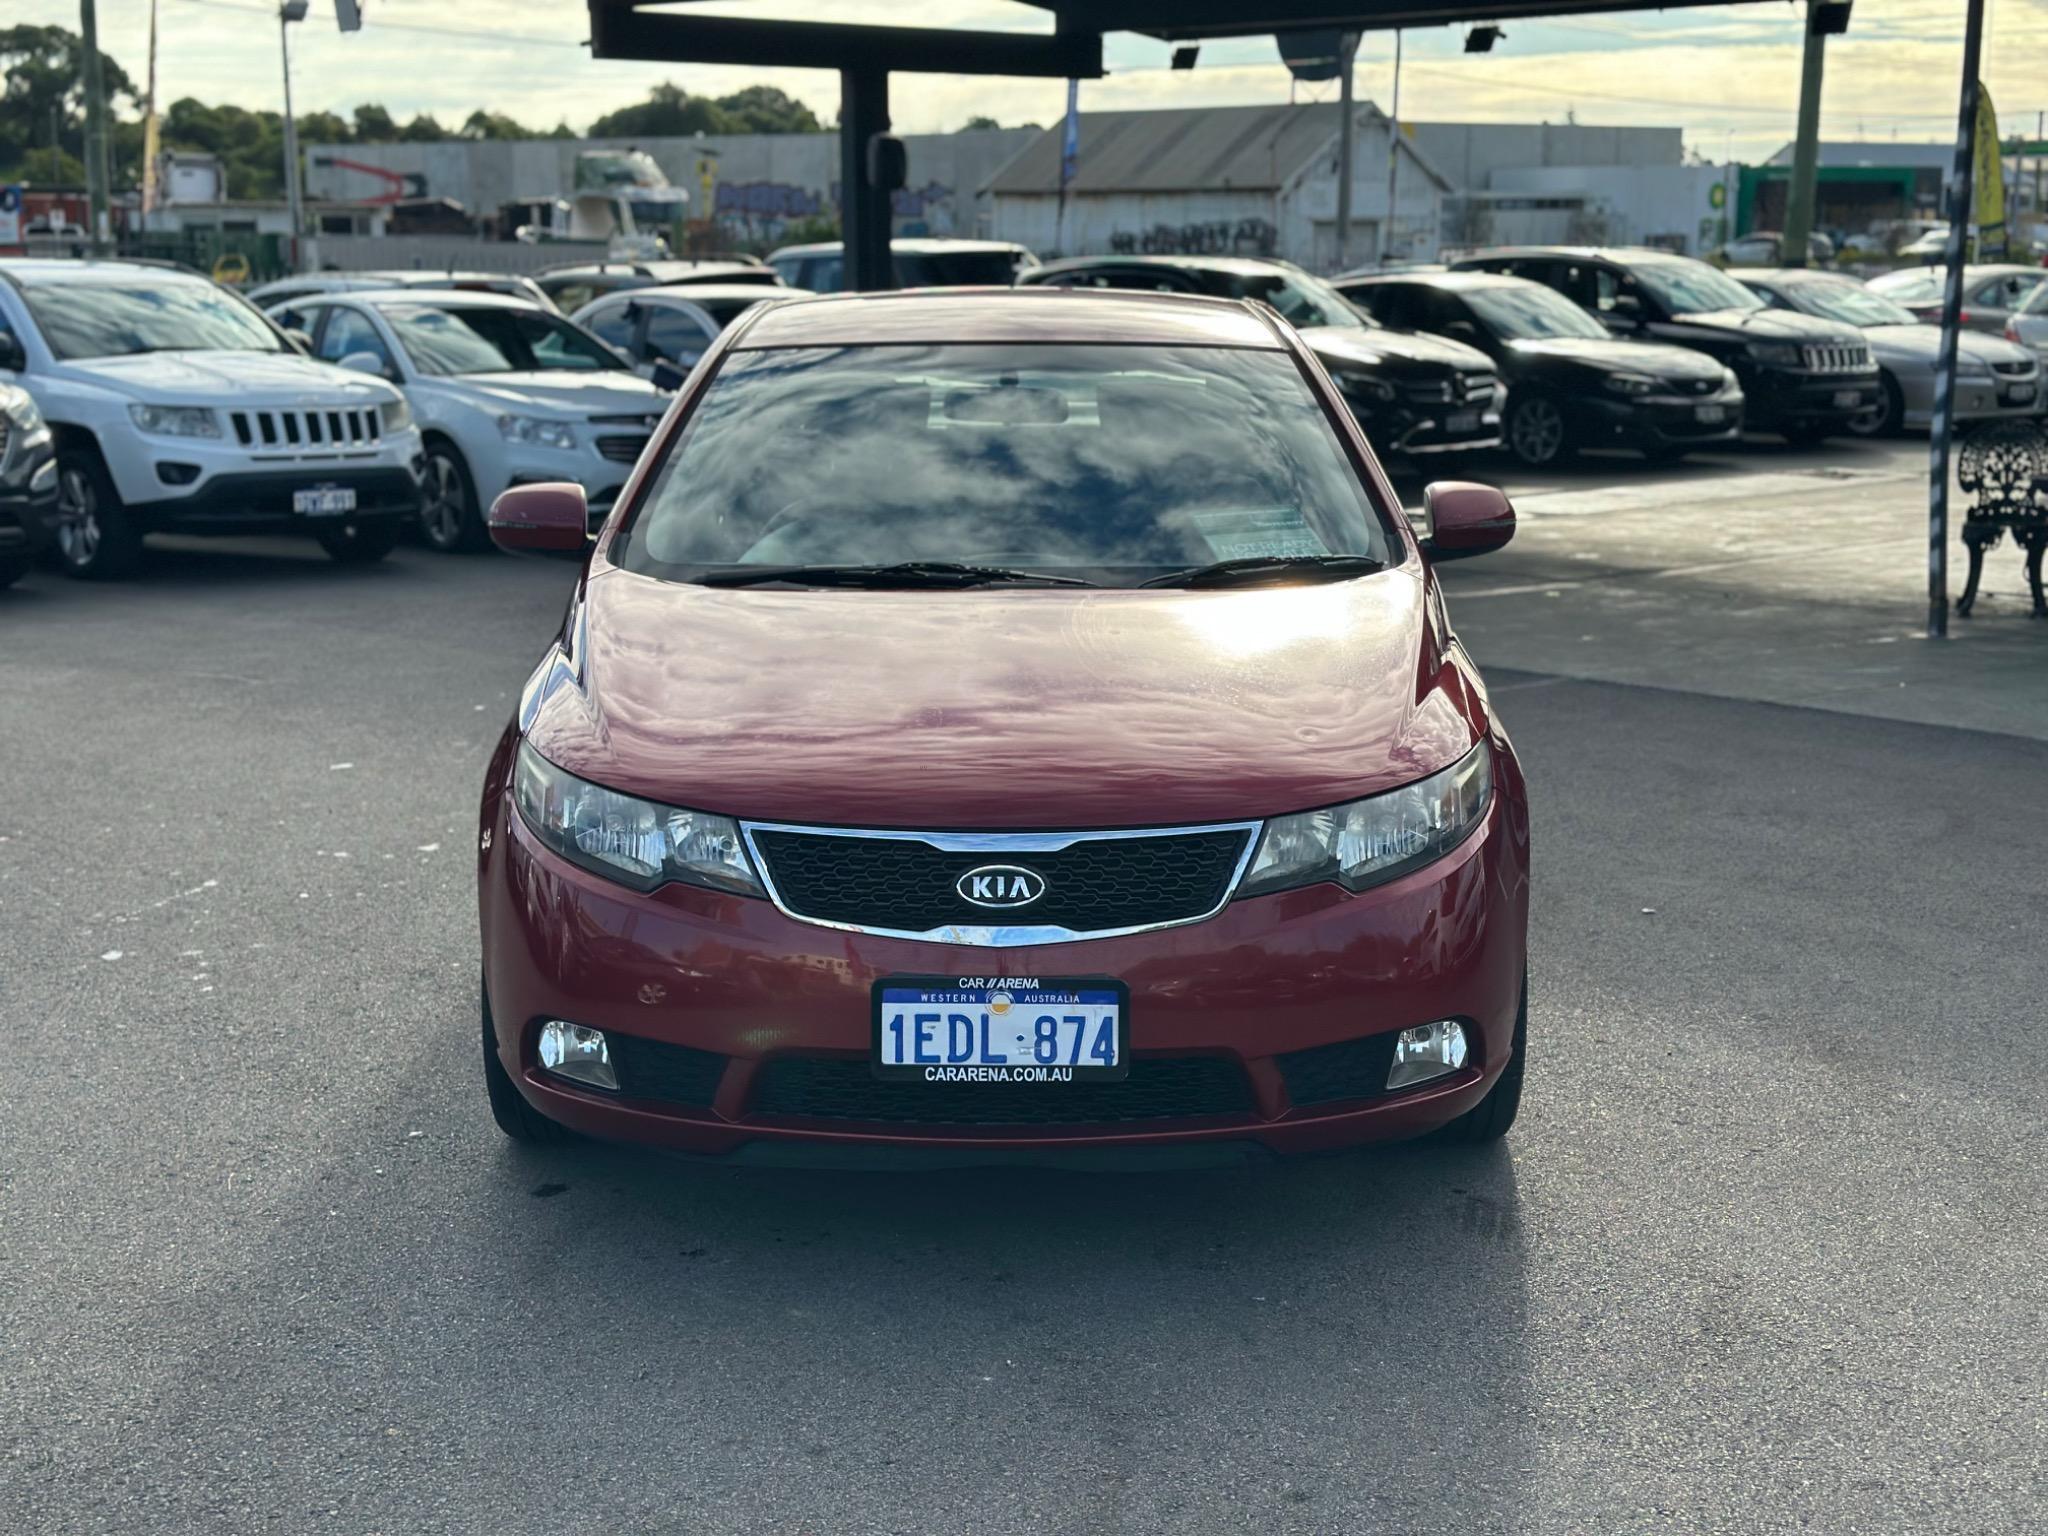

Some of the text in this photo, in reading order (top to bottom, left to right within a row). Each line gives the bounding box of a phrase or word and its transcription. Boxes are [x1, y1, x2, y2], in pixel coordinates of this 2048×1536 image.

[972, 876, 1031, 898] KIA
[959, 977, 984, 989] CAR
[920, 993, 1080, 1003] WESTERN AUSTRALIA
[889, 1013, 1115, 1066] 1EDL 874
[925, 1066, 1073, 1082] CARARENA.COM.AU
